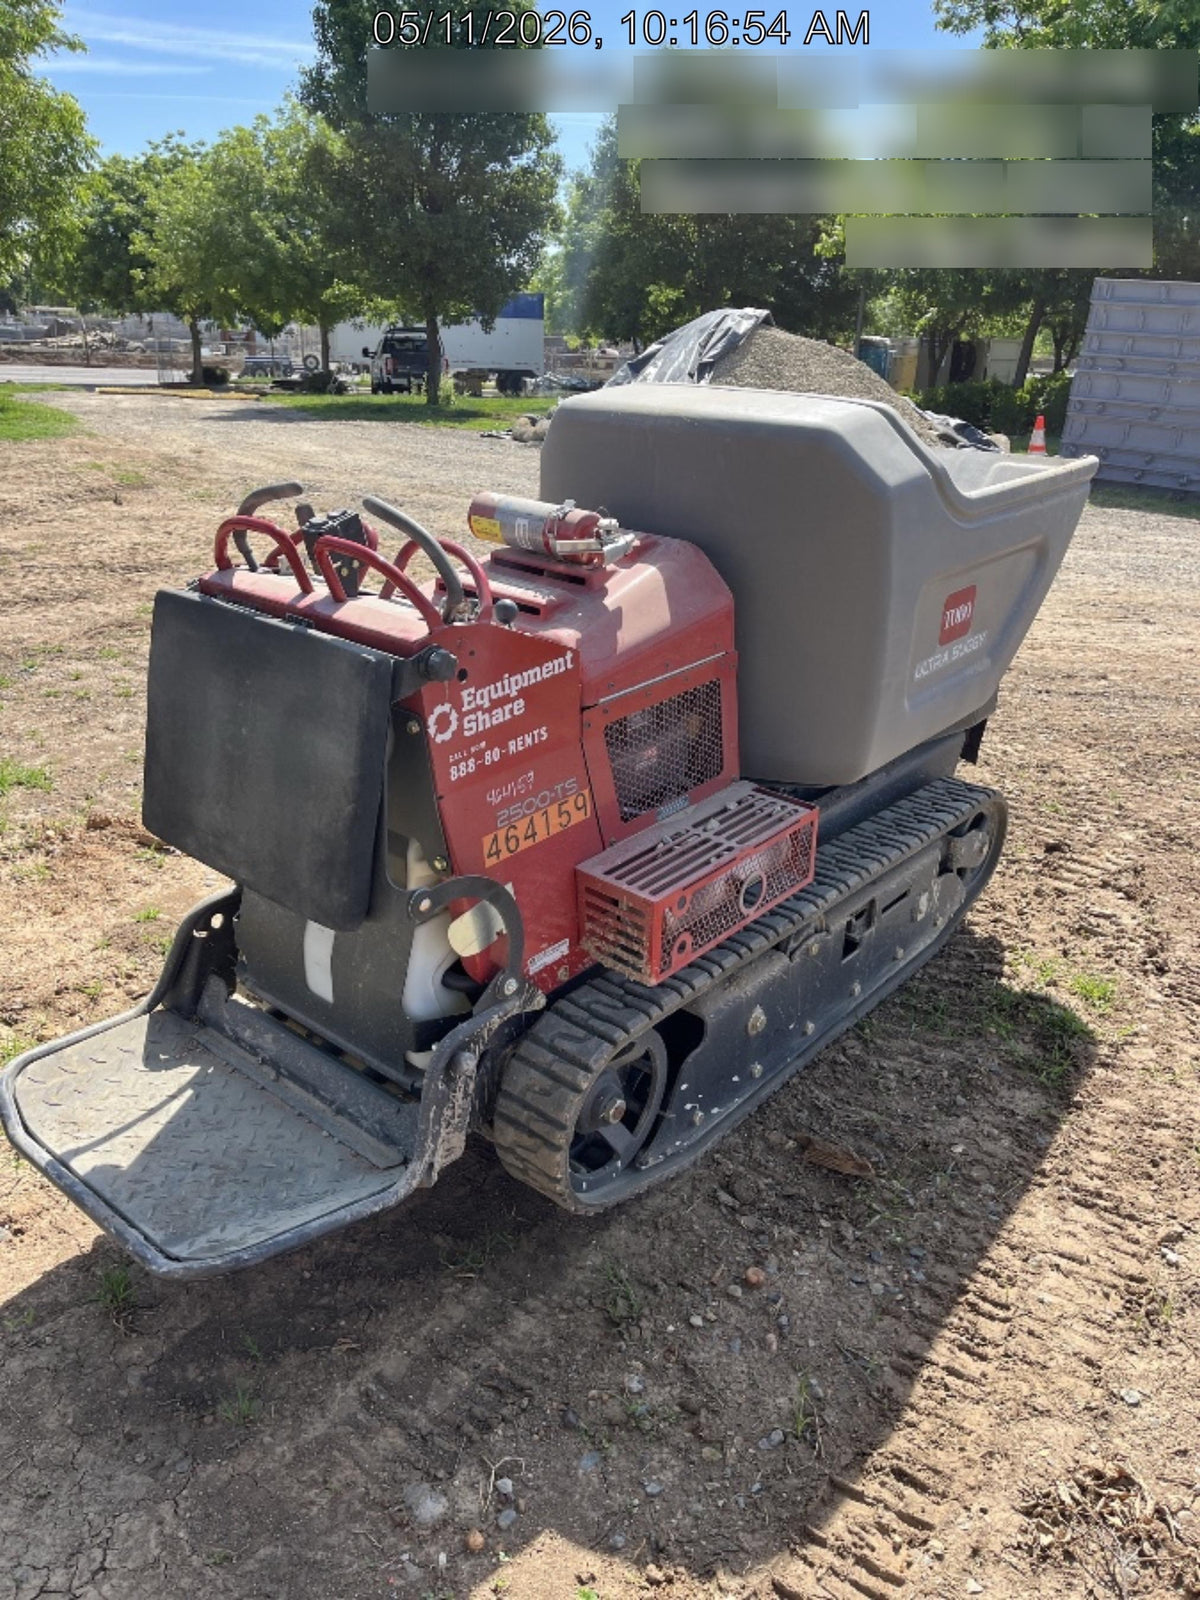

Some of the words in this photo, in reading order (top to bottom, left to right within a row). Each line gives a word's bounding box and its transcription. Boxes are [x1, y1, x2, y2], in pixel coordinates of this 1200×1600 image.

[461, 651, 574, 712] Equipment
[463, 698, 525, 737] Share
[486, 792, 588, 861] 464159
